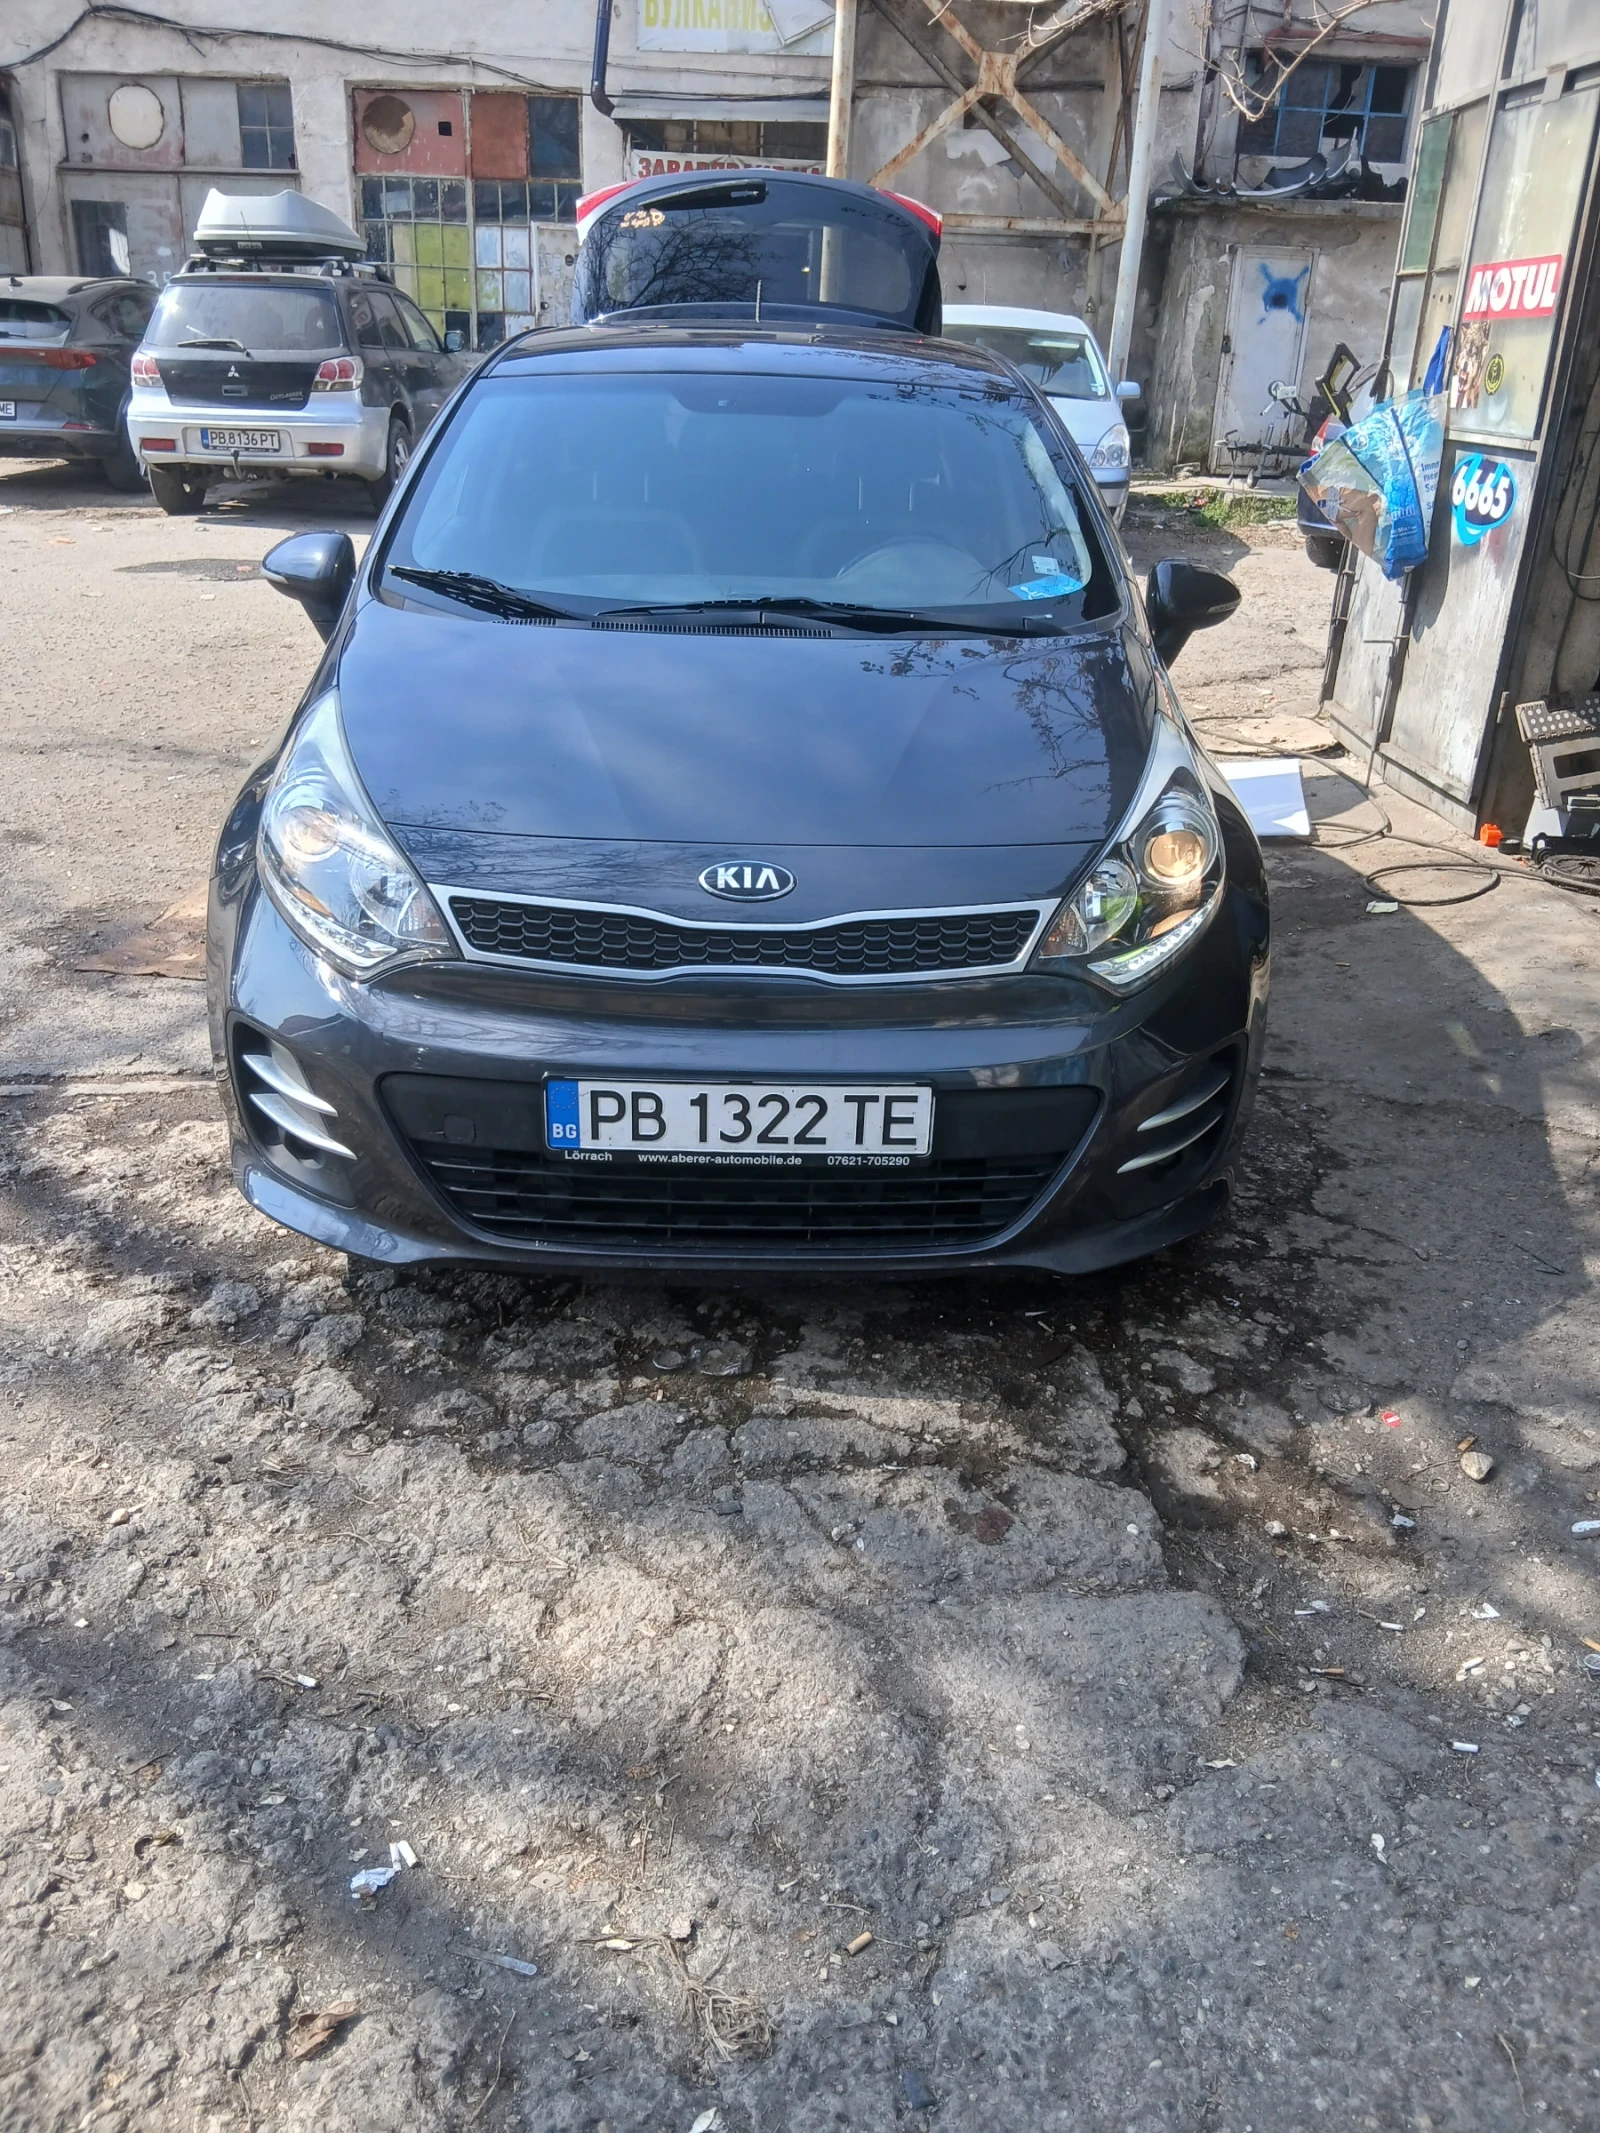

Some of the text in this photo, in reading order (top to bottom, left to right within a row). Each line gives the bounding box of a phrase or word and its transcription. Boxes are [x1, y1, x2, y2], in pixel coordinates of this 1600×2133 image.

[1465, 262, 1558, 313] MOTUL
[228, 431, 258, 446] 8136
[260, 433, 276, 447] PT
[1452, 465, 1510, 519] 6665
[717, 866, 780, 890] KIA
[552, 1090, 918, 1146] BG PB 1322 TE
[564, 1150, 910, 1166] Lörrach www.aberer-automobile.de 07621-705290
